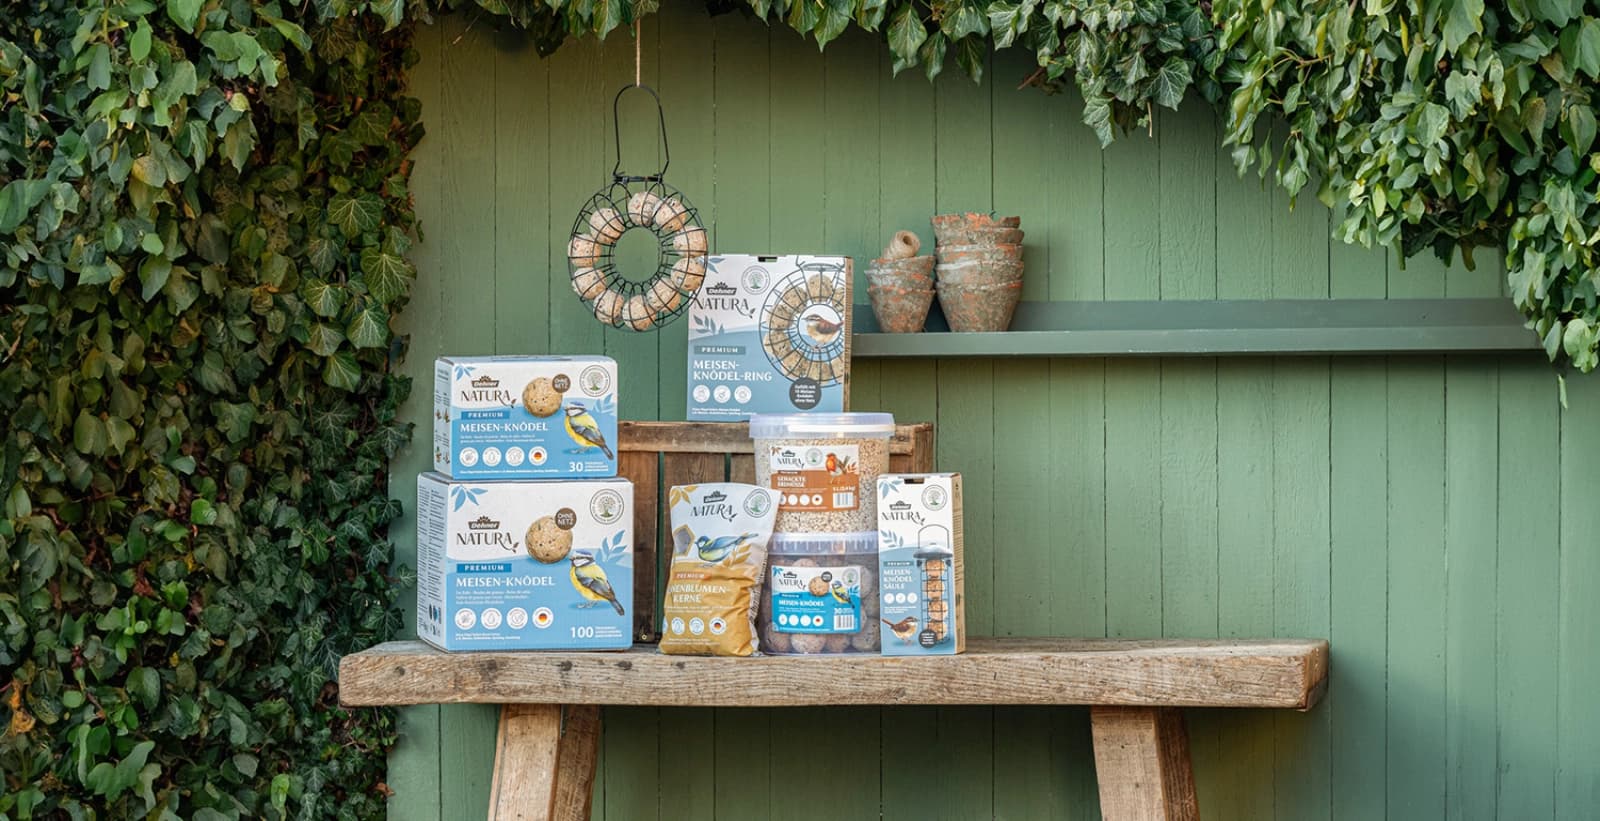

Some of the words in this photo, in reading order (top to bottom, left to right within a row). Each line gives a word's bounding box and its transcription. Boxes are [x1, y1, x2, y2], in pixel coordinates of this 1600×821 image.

[694, 297, 752, 315] NATURA
[693, 360, 740, 370] MEISEN-
[693, 370, 772, 381] KNÖDEL-RING
[461, 389, 514, 405] NATURA
[459, 421, 549, 432] MEISEN-KNÖDEL
[569, 461, 584, 472] 30
[690, 503, 735, 519] NATURA
[881, 511, 923, 524] NATURA
[457, 532, 515, 550] NATURA
[456, 575, 556, 588] MEISEN-KNÖDEL
[570, 626, 594, 639] 100
